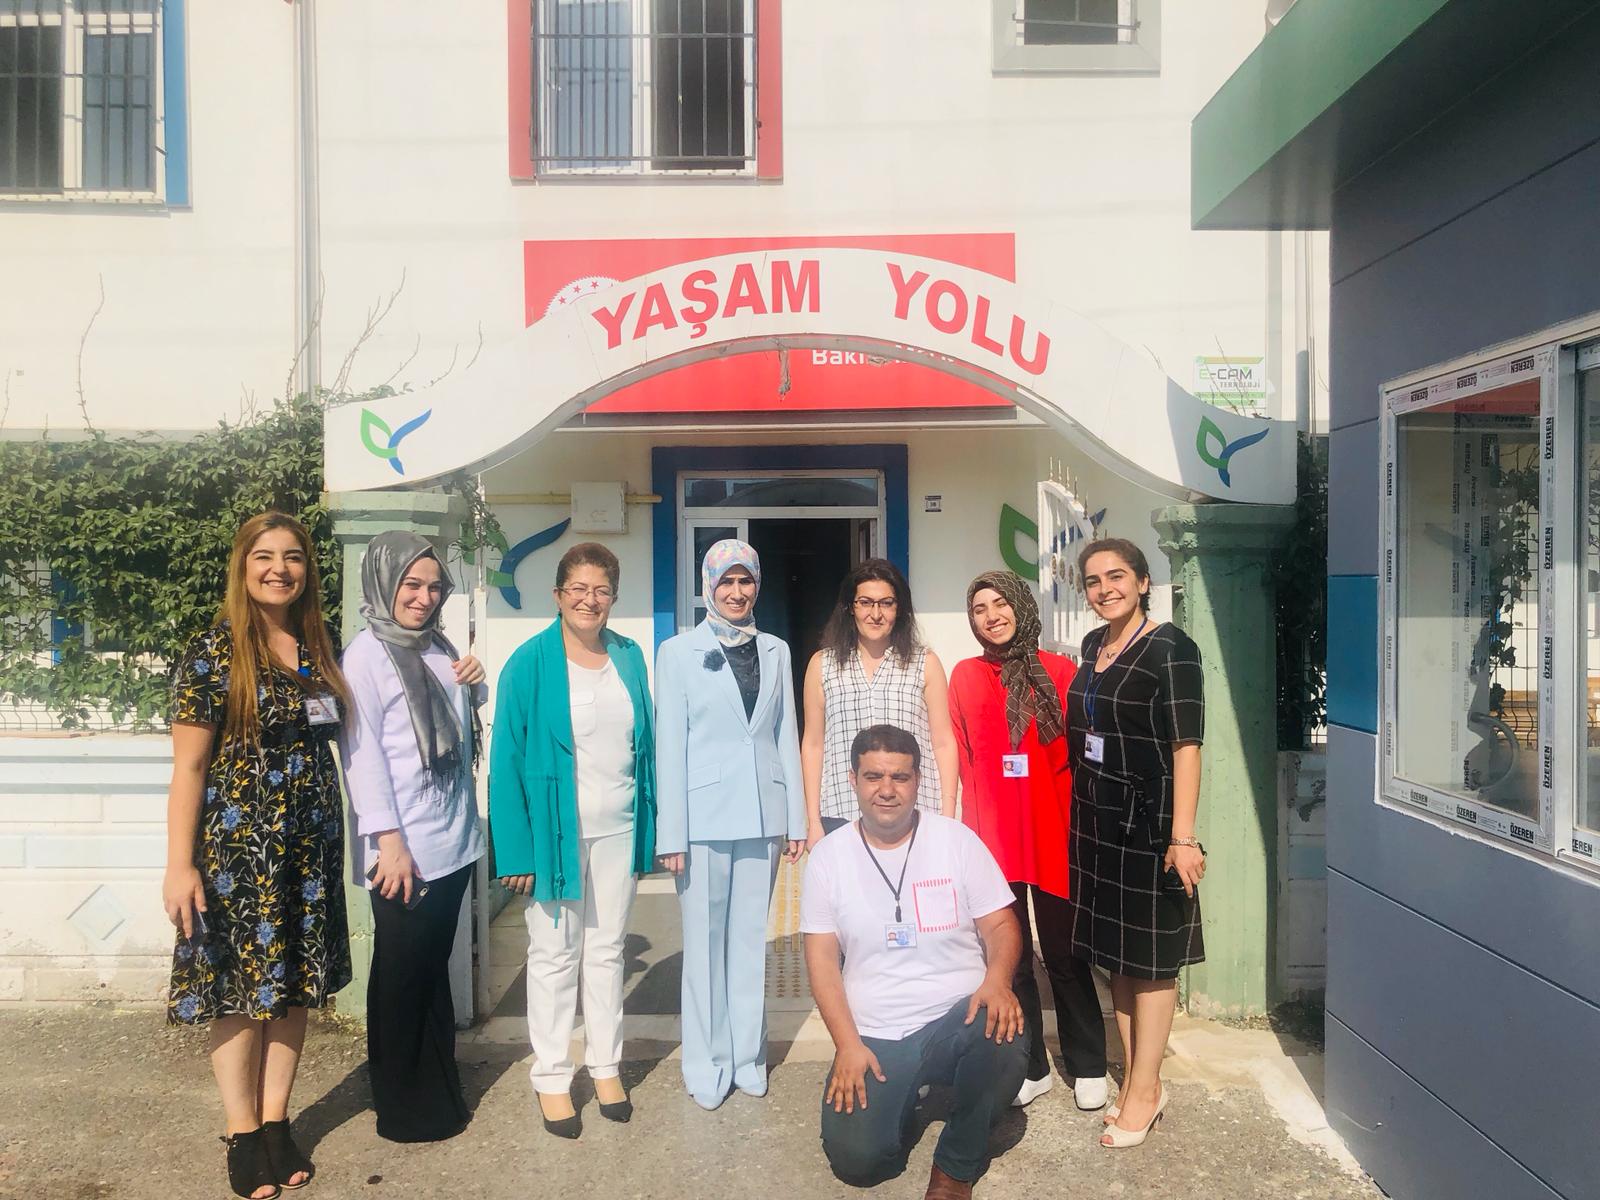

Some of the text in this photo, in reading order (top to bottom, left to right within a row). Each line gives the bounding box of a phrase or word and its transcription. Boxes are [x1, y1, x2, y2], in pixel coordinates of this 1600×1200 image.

[592, 260, 1051, 376] YAŞAM YOLU
[1511, 358, 1534, 373] ÖZEREN
[1544, 417, 1553, 459] ÖZEREN
[1543, 527, 1552, 569] ÖZEREN
[1543, 637, 1552, 679] ÖZEREN
[1542, 746, 1552, 788] ÖZEREN
[1456, 804, 1477, 821] ÖZEREN
[1510, 822, 1534, 841] ÖZEREN
